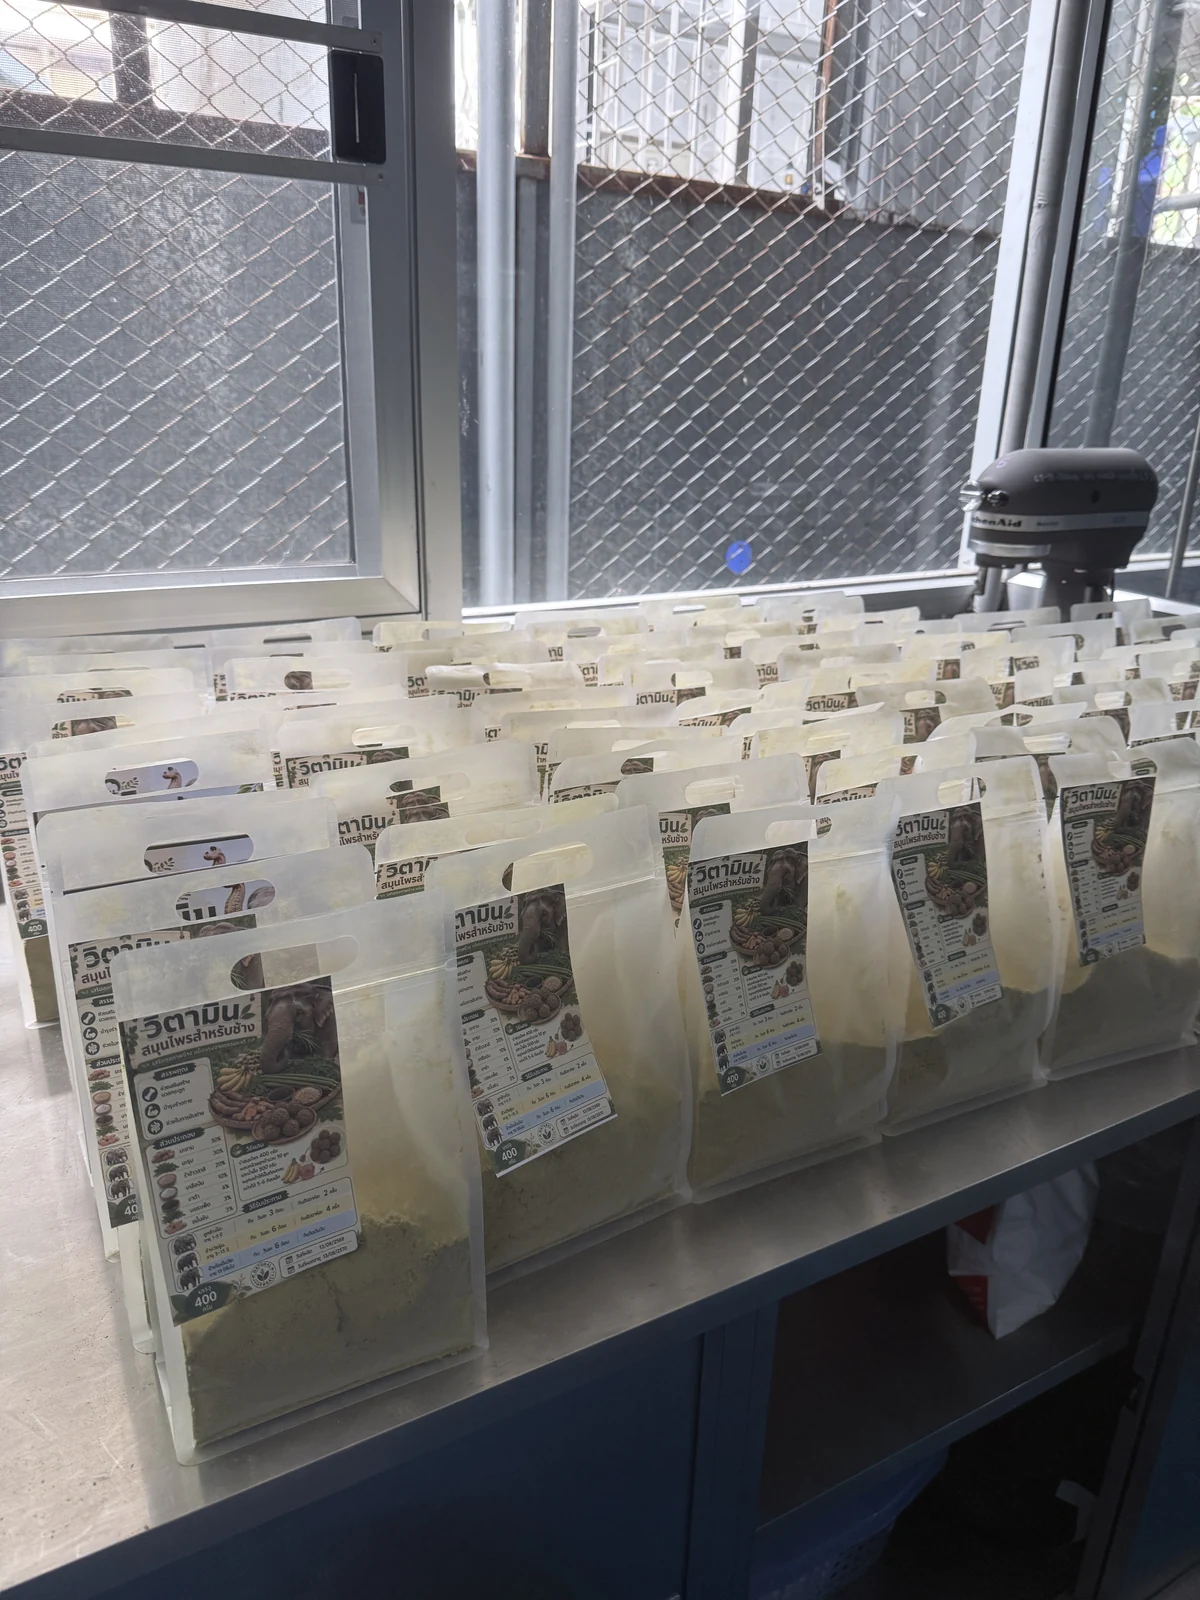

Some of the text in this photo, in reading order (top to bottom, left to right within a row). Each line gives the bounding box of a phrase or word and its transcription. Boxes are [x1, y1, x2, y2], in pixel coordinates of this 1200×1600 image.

[1071, 786, 1112, 804] วิตามิน
[696, 859, 753, 883] วิตามิน
[693, 876, 760, 897] สมุนไพรสำหรับช้าง
[144, 1002, 241, 1039] วิตามิน
[142, 1022, 256, 1058] สมุนไพรสำหรับช้าง
[727, 1072, 739, 1084] 400
[502, 1148, 518, 1161] 400
[323, 1189, 329, 1197] 2
[269, 1208, 275, 1216] 3
[325, 1204, 331, 1212] 4
[271, 1224, 277, 1233] 6
[274, 1240, 280, 1249] 6
[194, 1291, 217, 1307] 400
